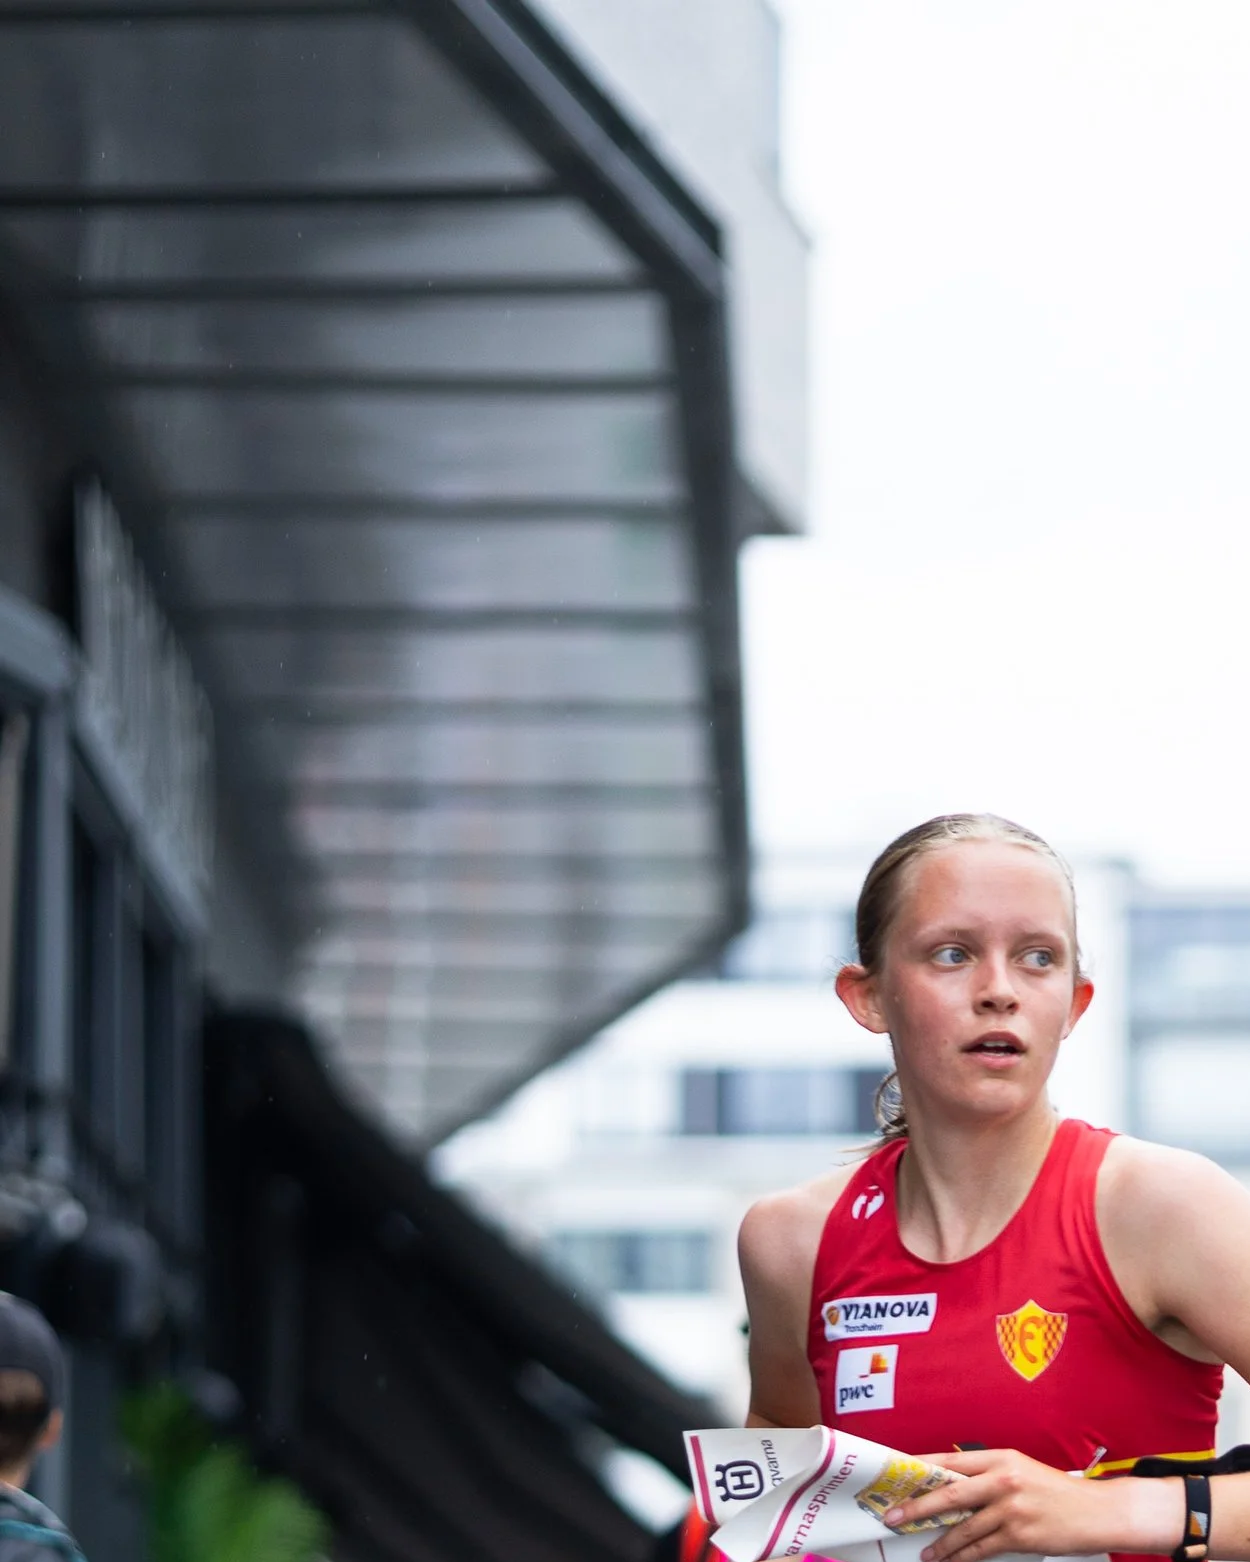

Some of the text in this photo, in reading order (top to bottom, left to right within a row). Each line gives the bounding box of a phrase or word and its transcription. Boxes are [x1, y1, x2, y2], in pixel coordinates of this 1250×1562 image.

[842, 1300, 930, 1321] VIANOVA
[839, 1384, 874, 1407] pwc
[784, 1453, 859, 1556] arnasprinten
